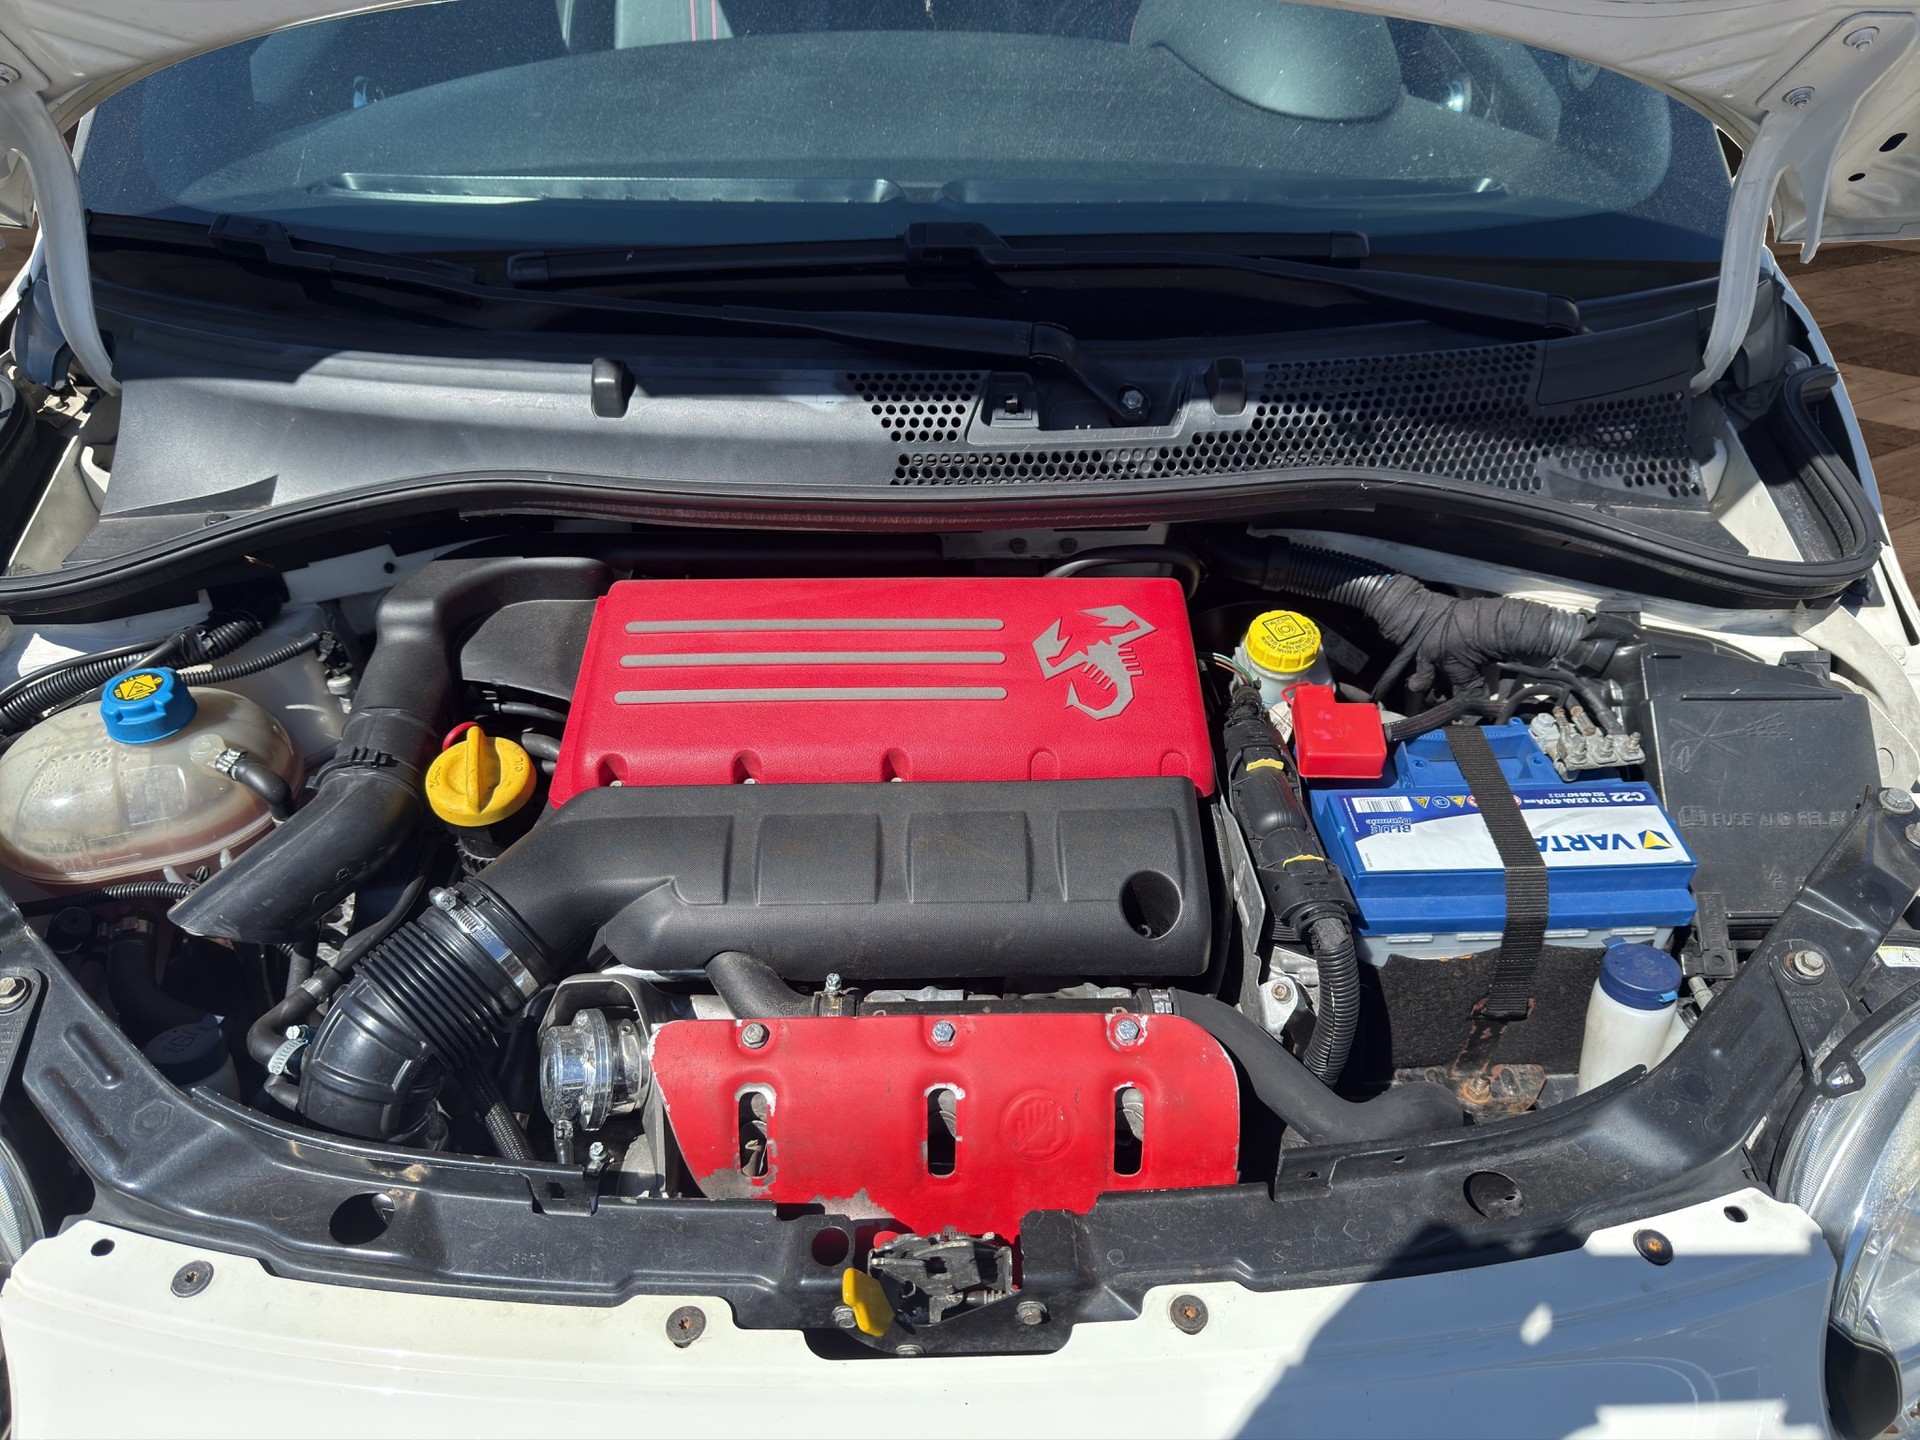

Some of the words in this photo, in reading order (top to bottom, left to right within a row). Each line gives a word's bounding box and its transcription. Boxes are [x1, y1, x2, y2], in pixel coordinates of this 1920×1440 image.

[1609, 791, 1646, 802] C22
[1759, 811, 1791, 827] AND
[1798, 810, 1847, 826] RELAY
[1370, 824, 1411, 834] BLUE
